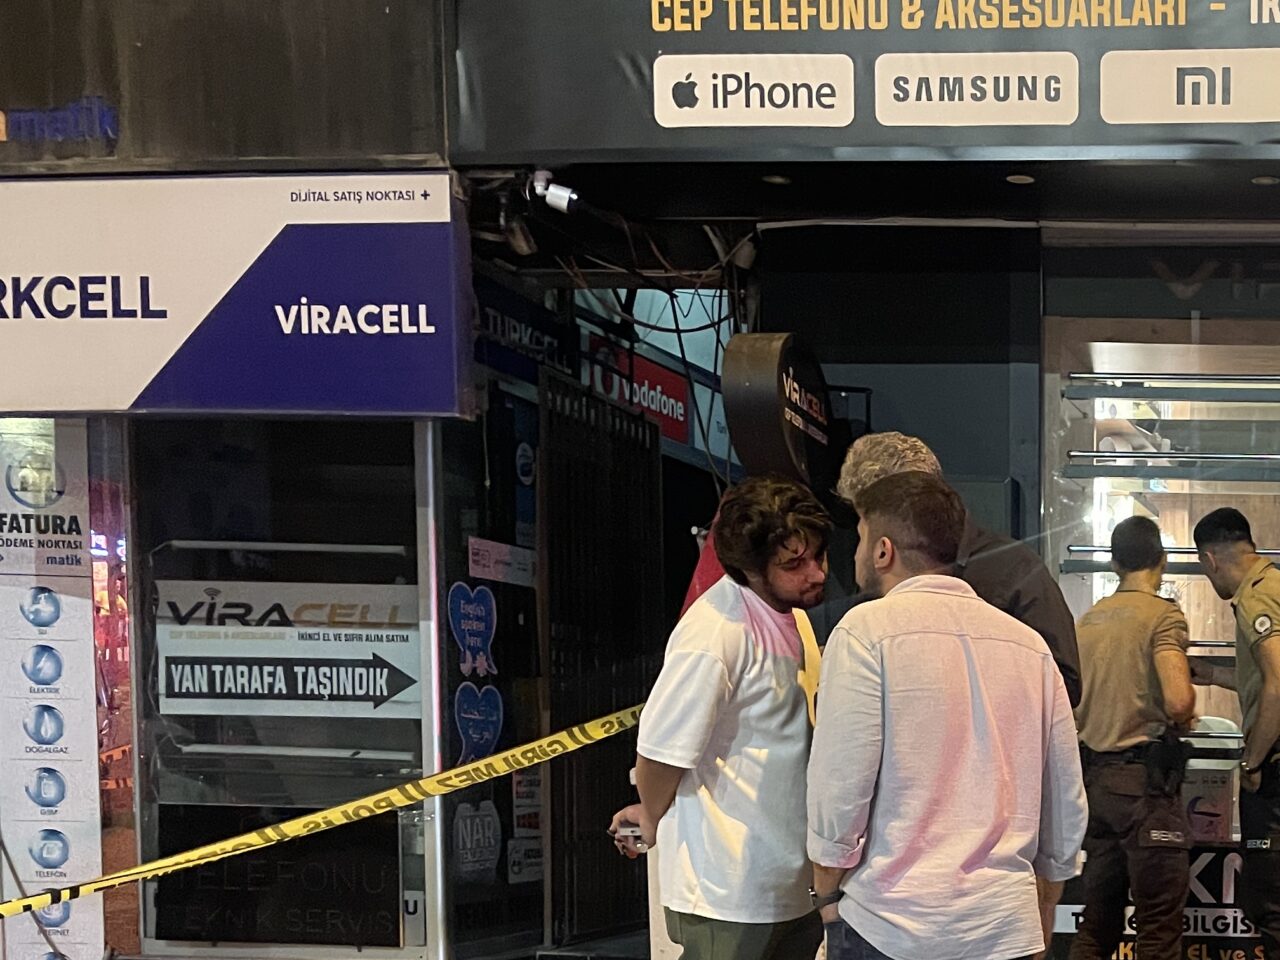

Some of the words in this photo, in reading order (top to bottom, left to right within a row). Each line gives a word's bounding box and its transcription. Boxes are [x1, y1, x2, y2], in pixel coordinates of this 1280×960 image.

[651, 0, 714, 32] CEP
[723, 0, 889, 31] TELEFONU
[711, 71, 837, 110] iPhone
[893, 74, 1062, 103] SAMSUNG
[333, 190, 362, 203] SATIŞ
[366, 190, 415, 201] NOKTASI
[275, 296, 435, 335] VİRACELL
[622, 378, 685, 421] vodafone
[0, 513, 82, 536] FATURA
[37, 539, 83, 550] NOKTASI
[171, 664, 209, 694] YAN
[211, 665, 287, 695] TARAFA
[293, 666, 389, 700] TAŞINDIK
